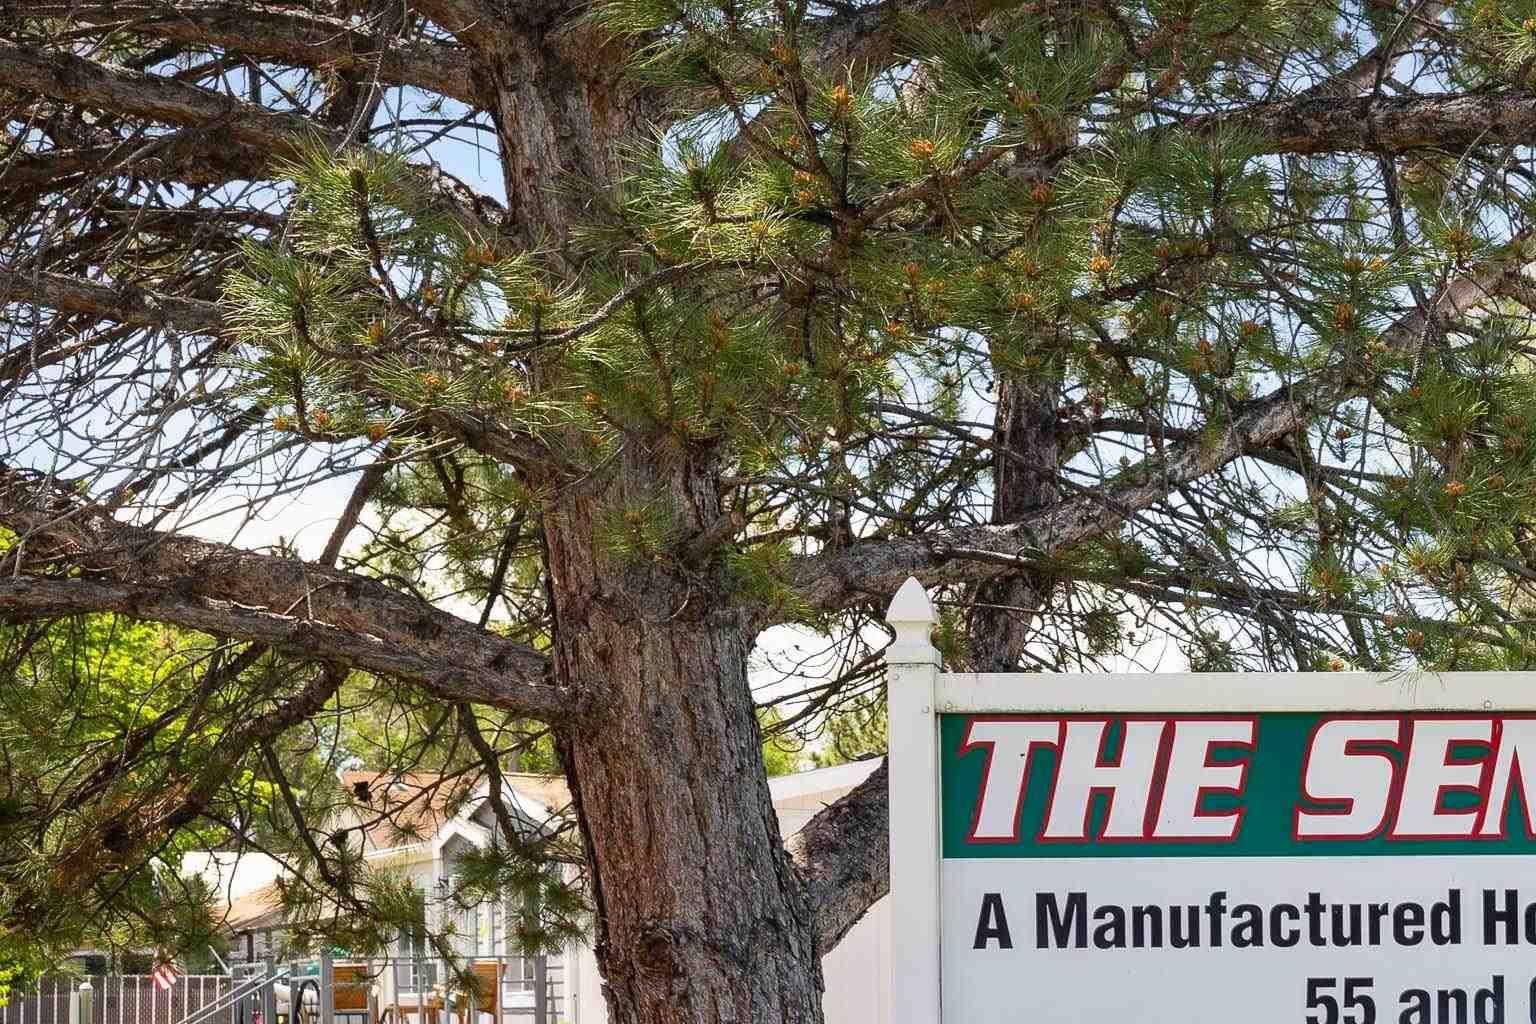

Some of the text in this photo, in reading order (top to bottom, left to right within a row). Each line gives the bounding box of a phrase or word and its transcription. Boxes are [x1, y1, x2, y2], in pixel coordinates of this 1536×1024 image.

[960, 714, 1258, 841] THE
[973, 894, 1013, 950] A
[1036, 889, 1462, 950] Manufactured
